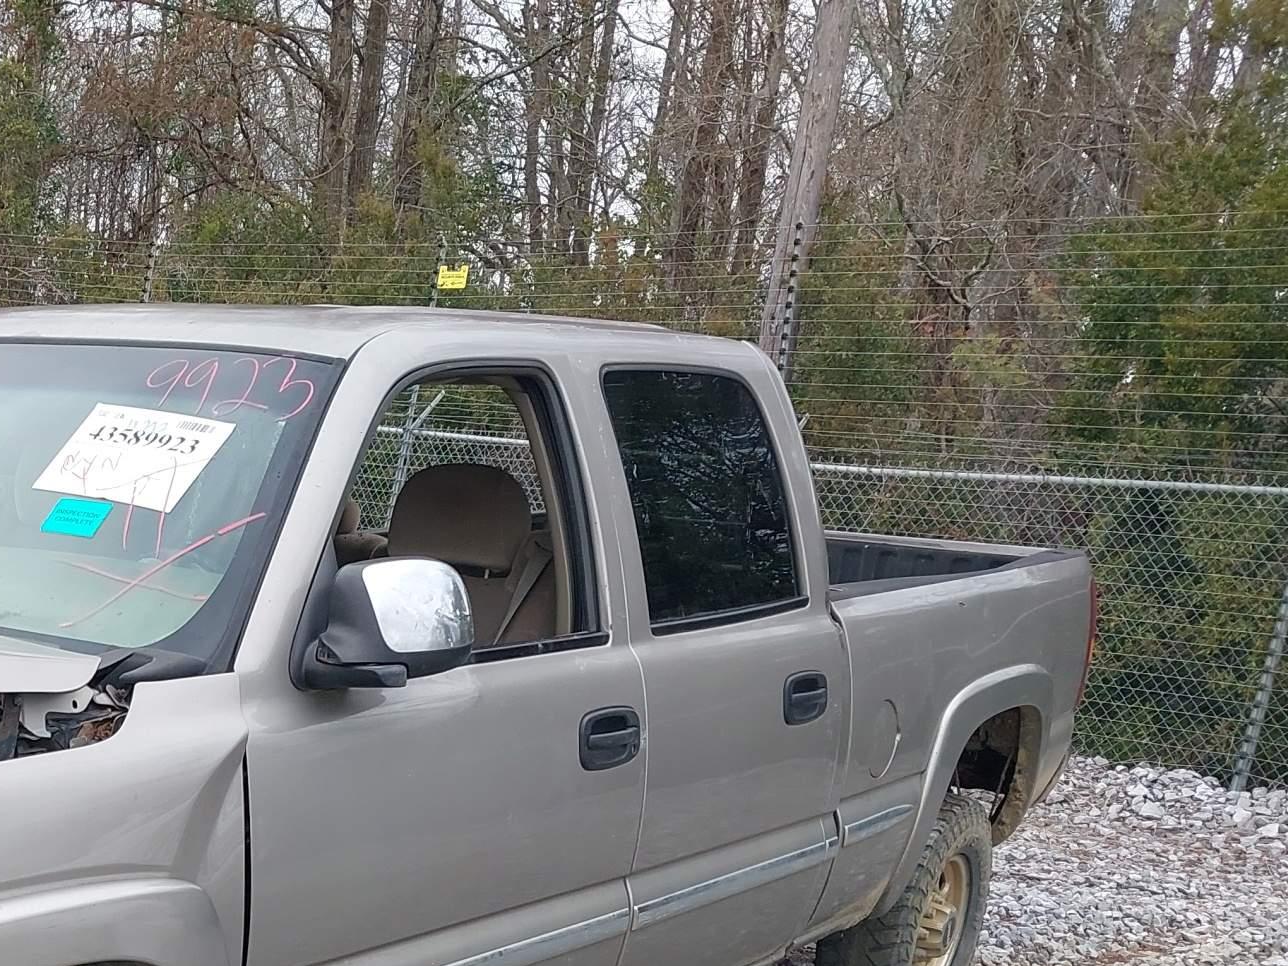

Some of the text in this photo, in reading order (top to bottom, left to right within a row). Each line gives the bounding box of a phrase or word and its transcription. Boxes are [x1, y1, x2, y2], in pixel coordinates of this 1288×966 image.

[146, 354, 314, 422] 9923
[88, 425, 200, 454] 43589923
[55, 516, 94, 526] COMPLETE
